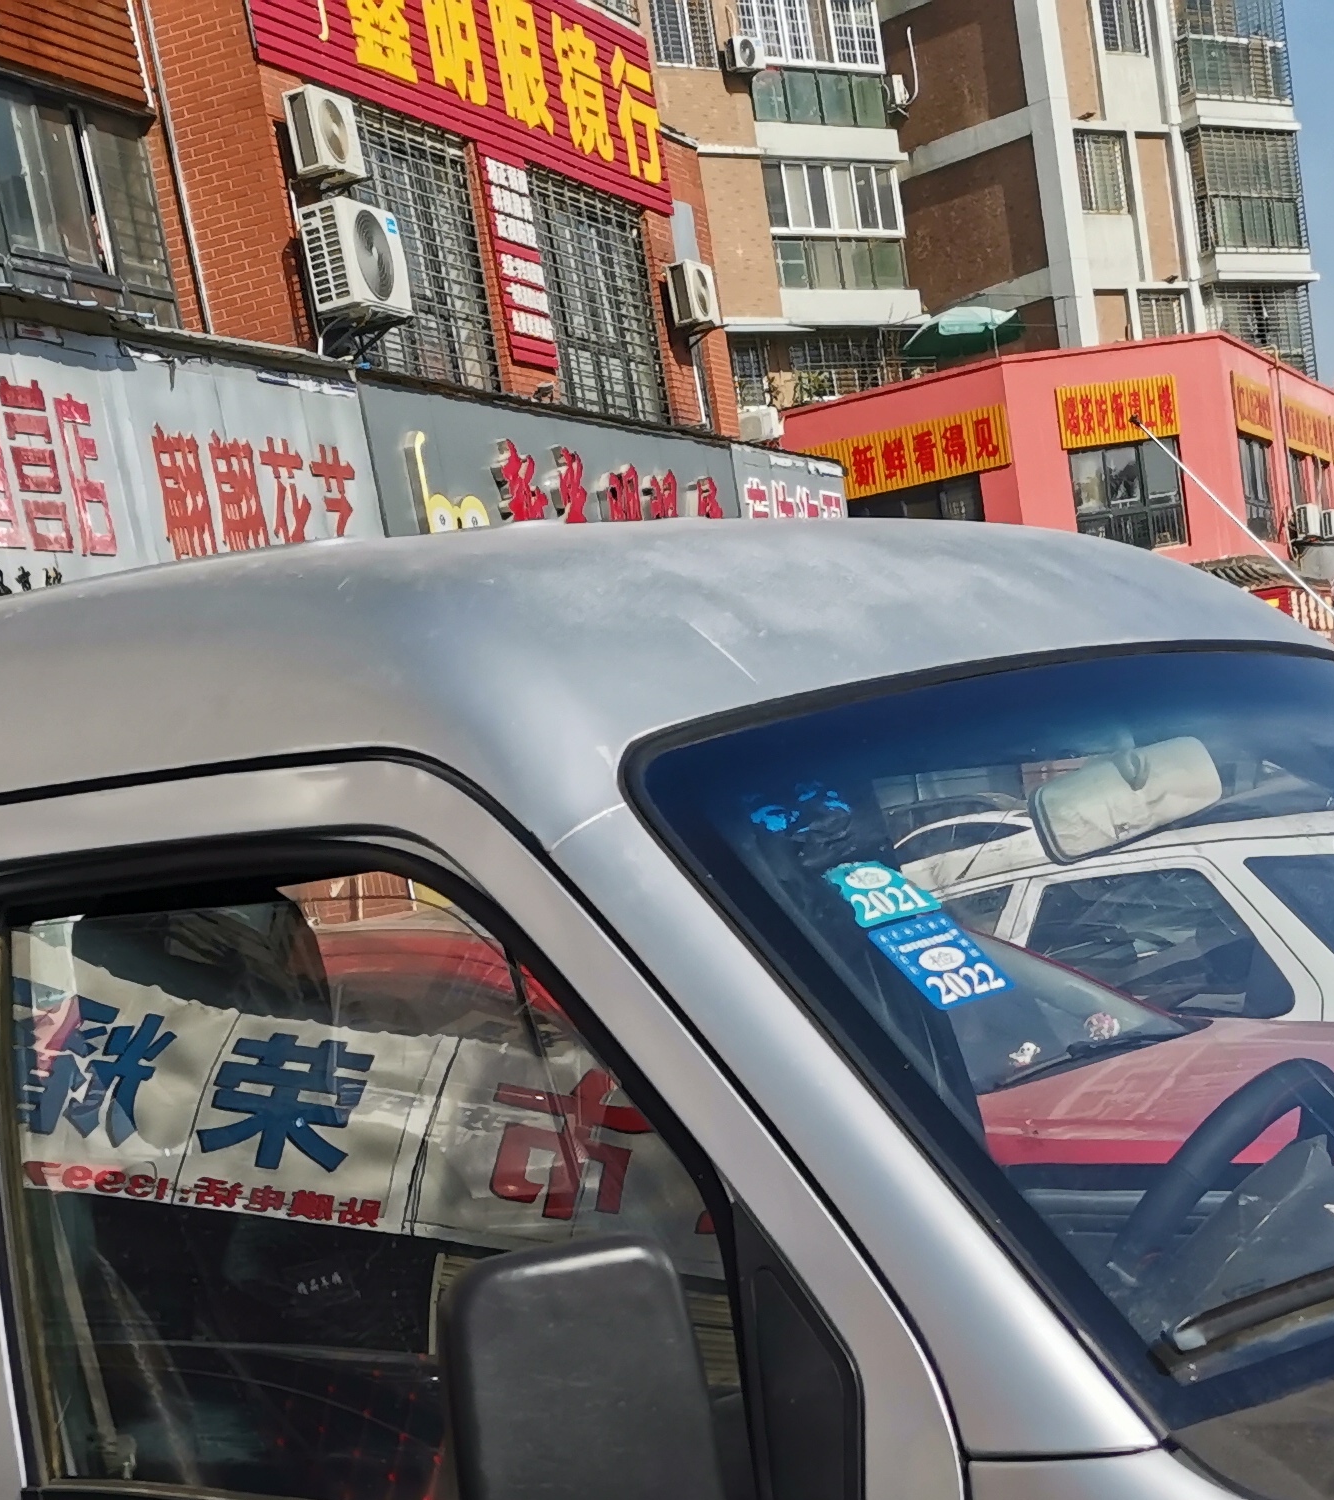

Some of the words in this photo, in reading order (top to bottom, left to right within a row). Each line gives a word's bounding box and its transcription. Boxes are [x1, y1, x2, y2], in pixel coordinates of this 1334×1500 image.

[851, 416, 1000, 488] 新鲜看得见
[849, 884, 931, 921] 2021
[925, 962, 1006, 1005] 2022
